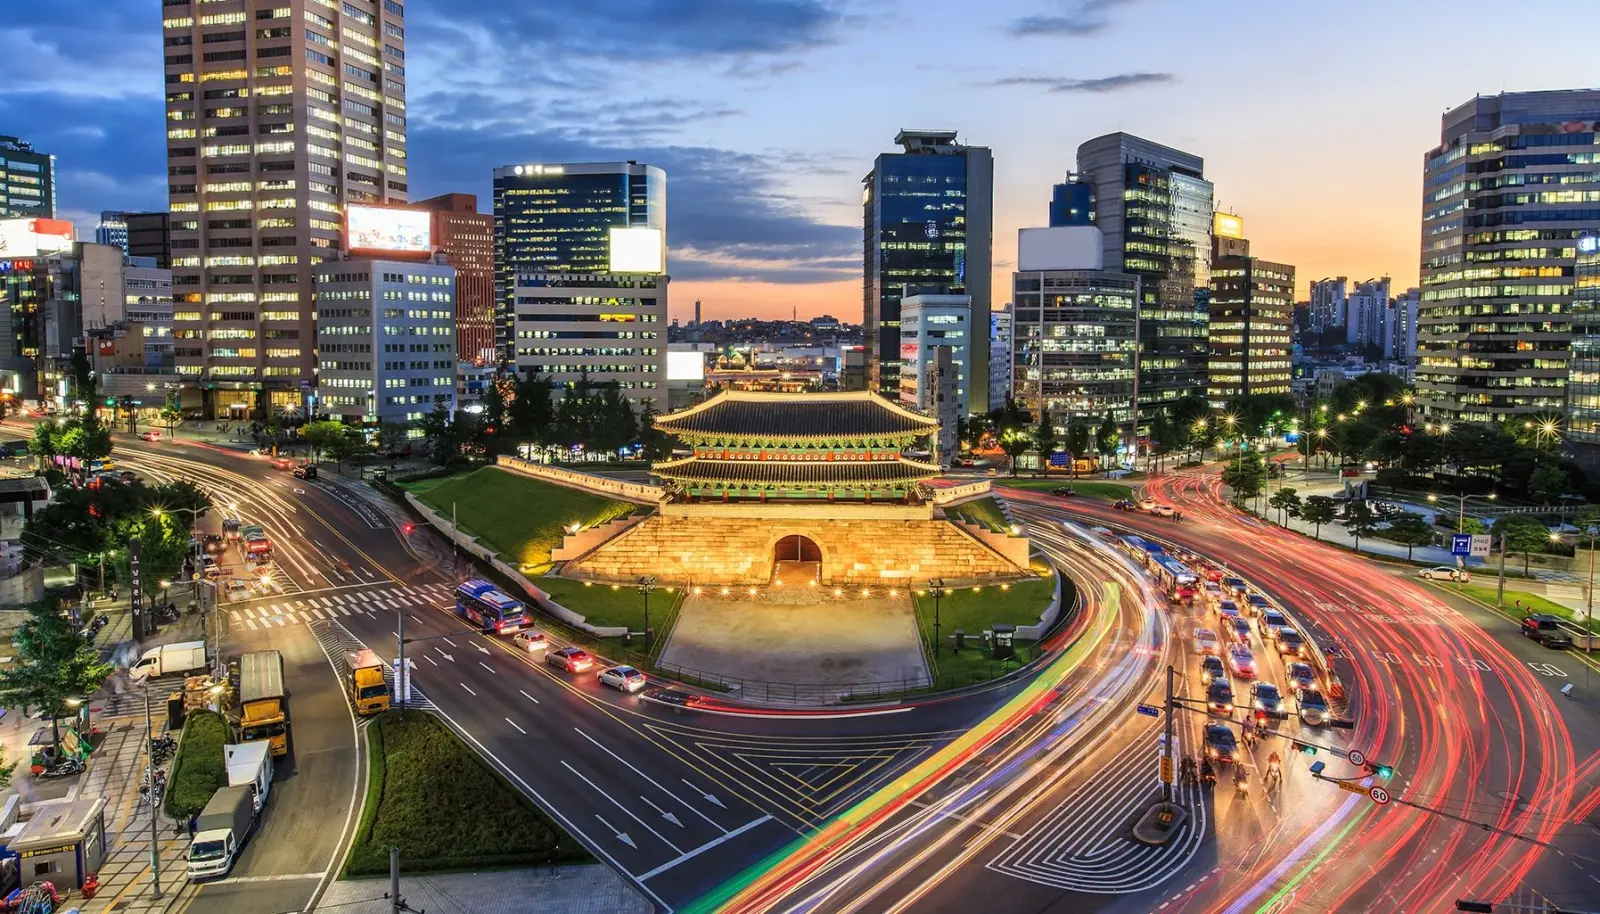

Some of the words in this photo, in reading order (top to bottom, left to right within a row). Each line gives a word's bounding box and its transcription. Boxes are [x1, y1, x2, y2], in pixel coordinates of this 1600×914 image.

[1527, 662, 1568, 677] 50
[1352, 754, 1362, 763] 50
[1373, 790, 1386, 801] 60
